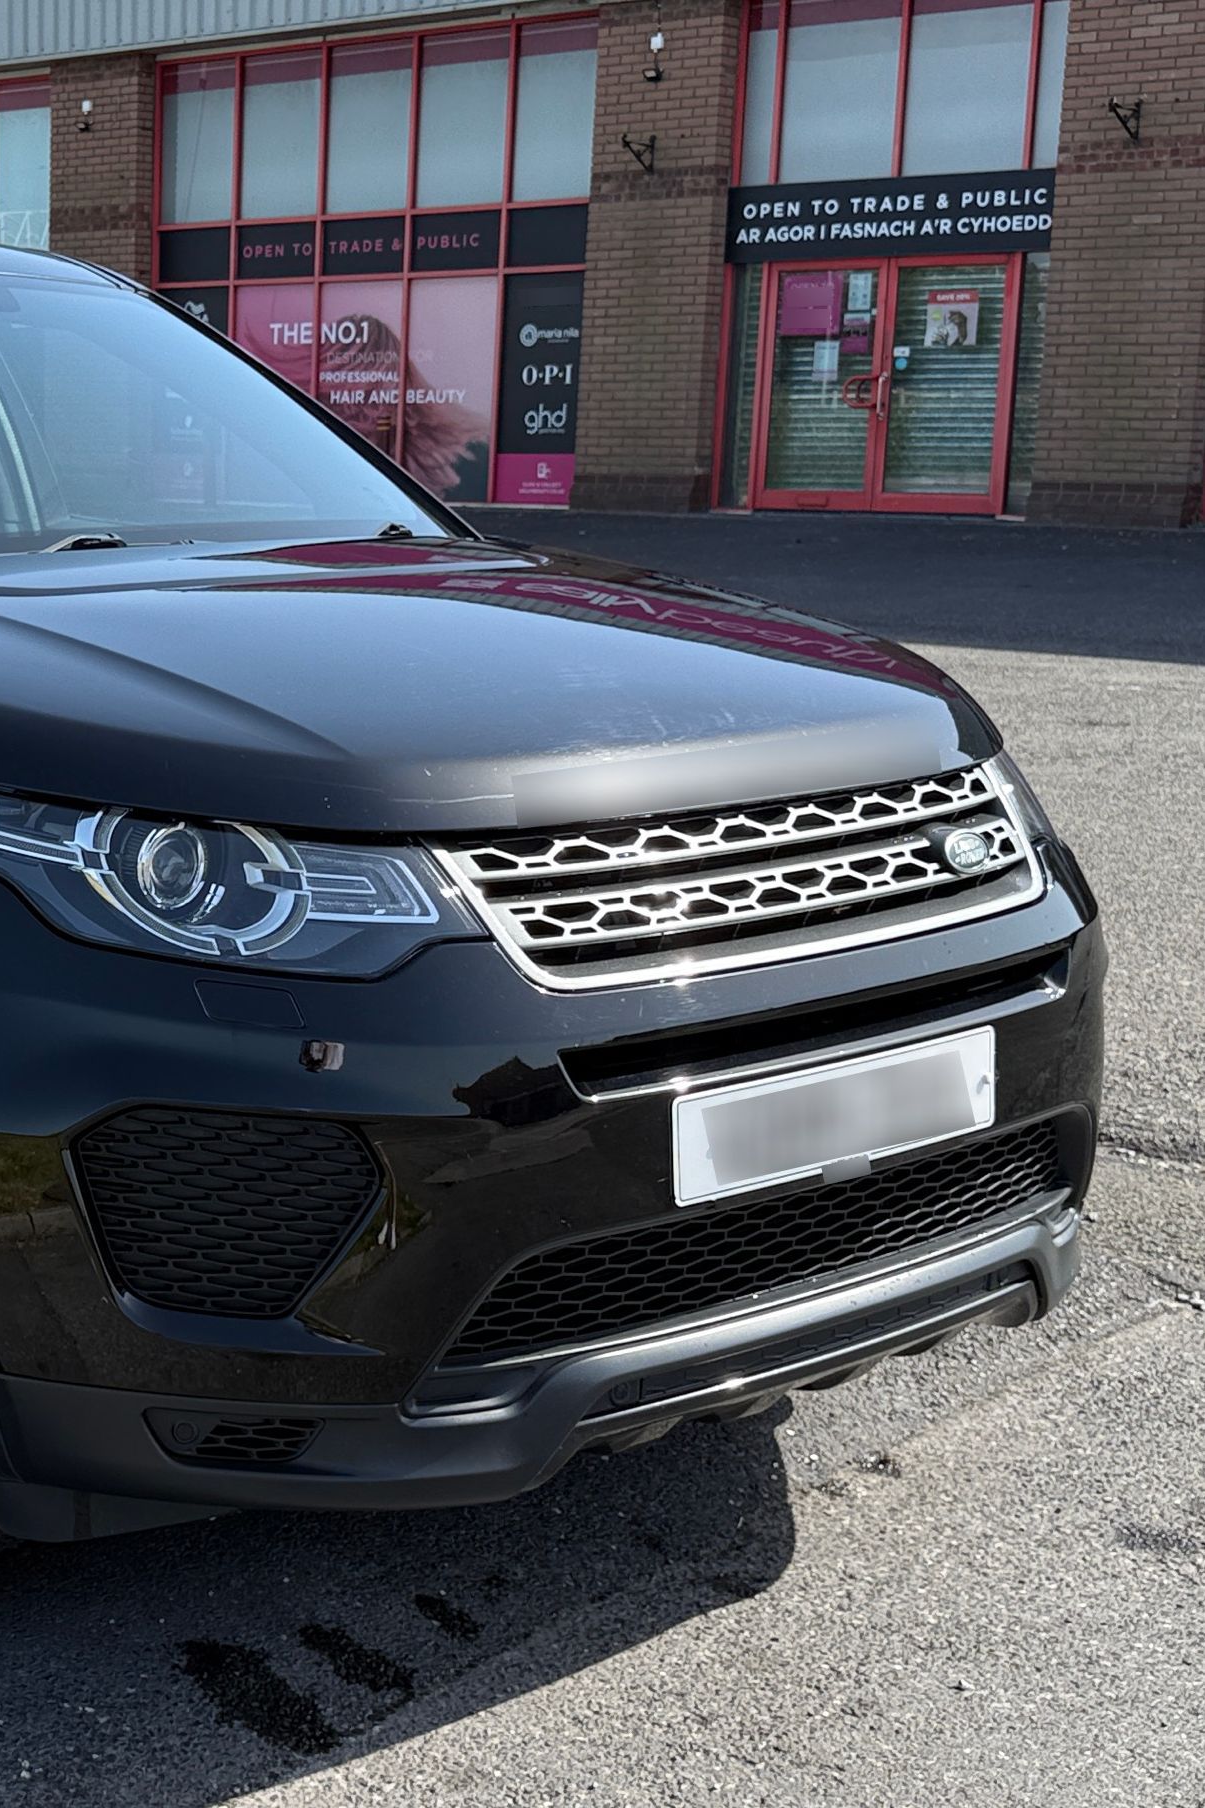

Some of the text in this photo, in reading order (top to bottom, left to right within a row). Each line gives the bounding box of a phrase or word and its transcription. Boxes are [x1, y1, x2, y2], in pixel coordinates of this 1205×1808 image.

[742, 187, 1048, 220] OPEN TO TRADE & PUBLIC
[735, 213, 1052, 245] AR AGOR I FASNACH A'R CYHOEDD
[242, 233, 480, 258] OPEN TO TRADE & PUBLIC
[269, 321, 369, 345] THE NO.1
[326, 351, 398, 364] DESTINATION
[319, 371, 399, 383] PROFESSIONAL
[330, 389, 466, 405] HAIR AND BEAUTY
[523, 403, 567, 435] ghd
